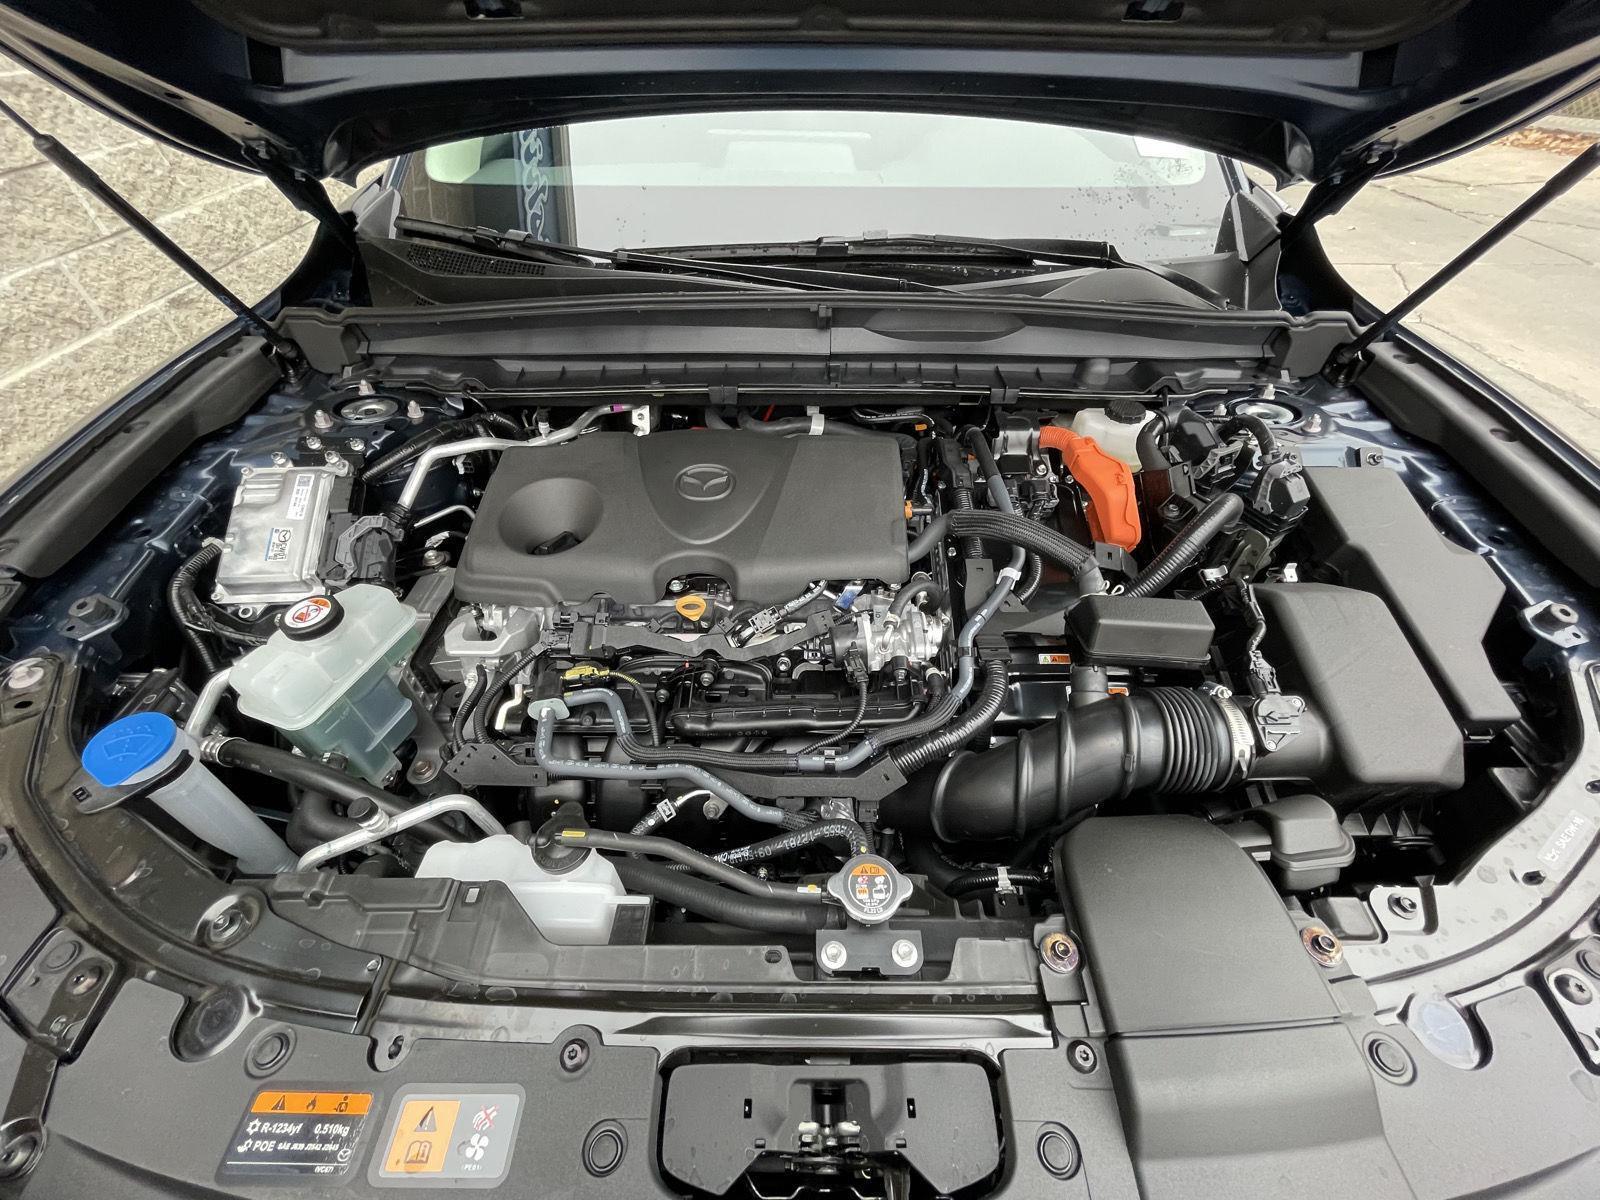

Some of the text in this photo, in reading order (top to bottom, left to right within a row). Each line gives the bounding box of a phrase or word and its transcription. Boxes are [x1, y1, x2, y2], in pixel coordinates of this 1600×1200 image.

[260, 1122, 350, 1137] R-1234yf 0.510kg
[252, 1140, 276, 1152] POE
